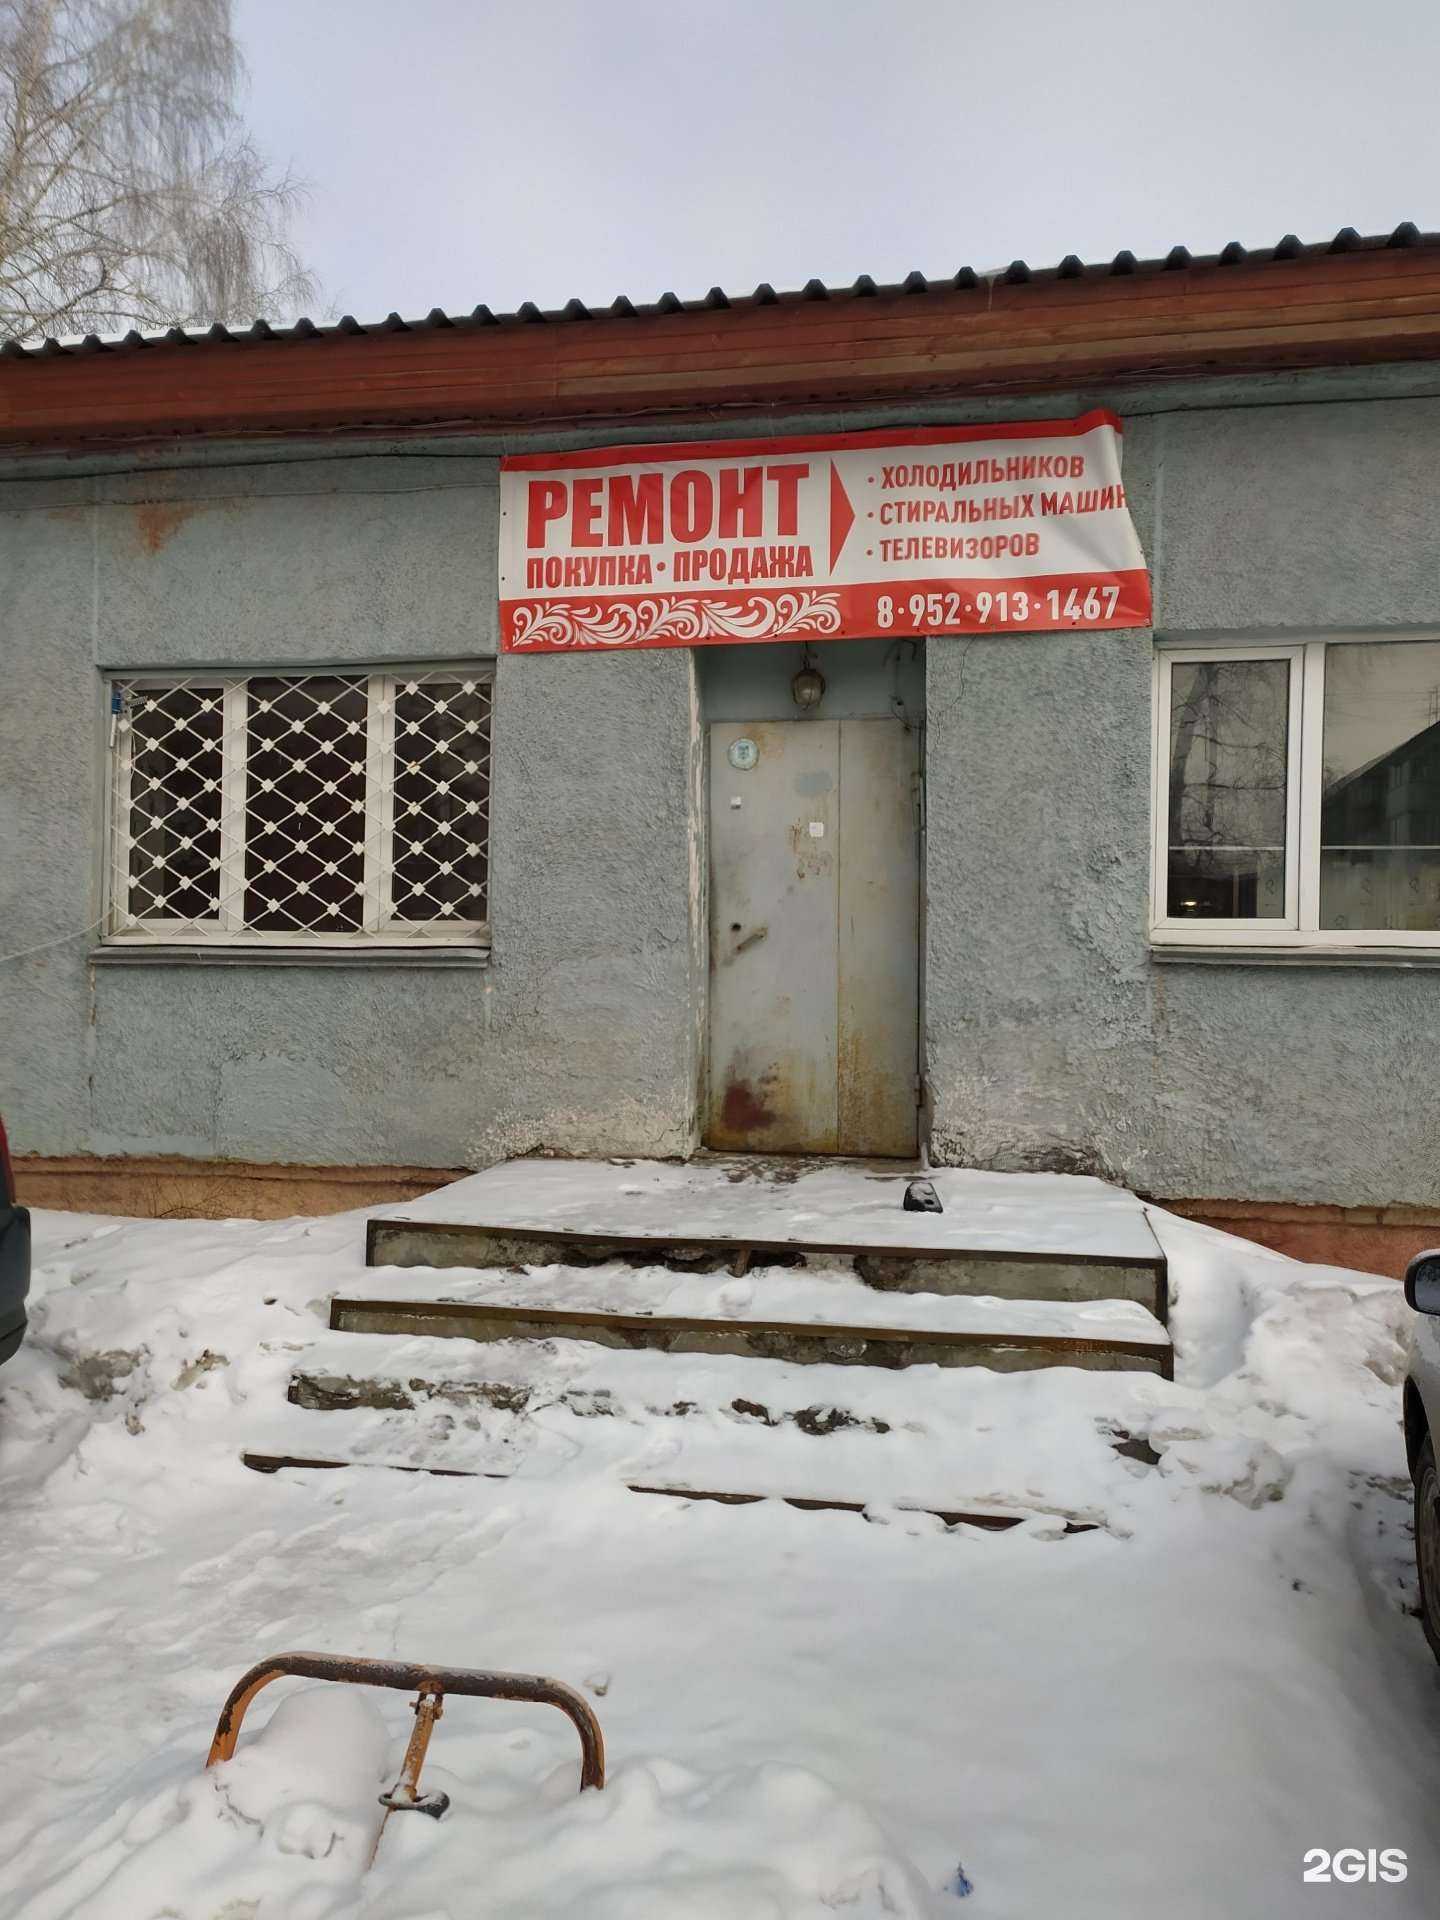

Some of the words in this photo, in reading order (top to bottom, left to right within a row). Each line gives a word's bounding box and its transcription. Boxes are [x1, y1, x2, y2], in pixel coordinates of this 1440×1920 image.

[881, 455, 1085, 492] ХОЛОДИЛЬНИКОВ
[527, 463, 809, 549] РЕМОНТ
[880, 493, 1035, 526] СТИРАЛЬНЫХ
[880, 532, 1040, 562] ТЕЛЕВИЗОРОВ
[527, 554, 653, 589] ПОКУПКА
[673, 545, 814, 585] ПРОДАЖА
